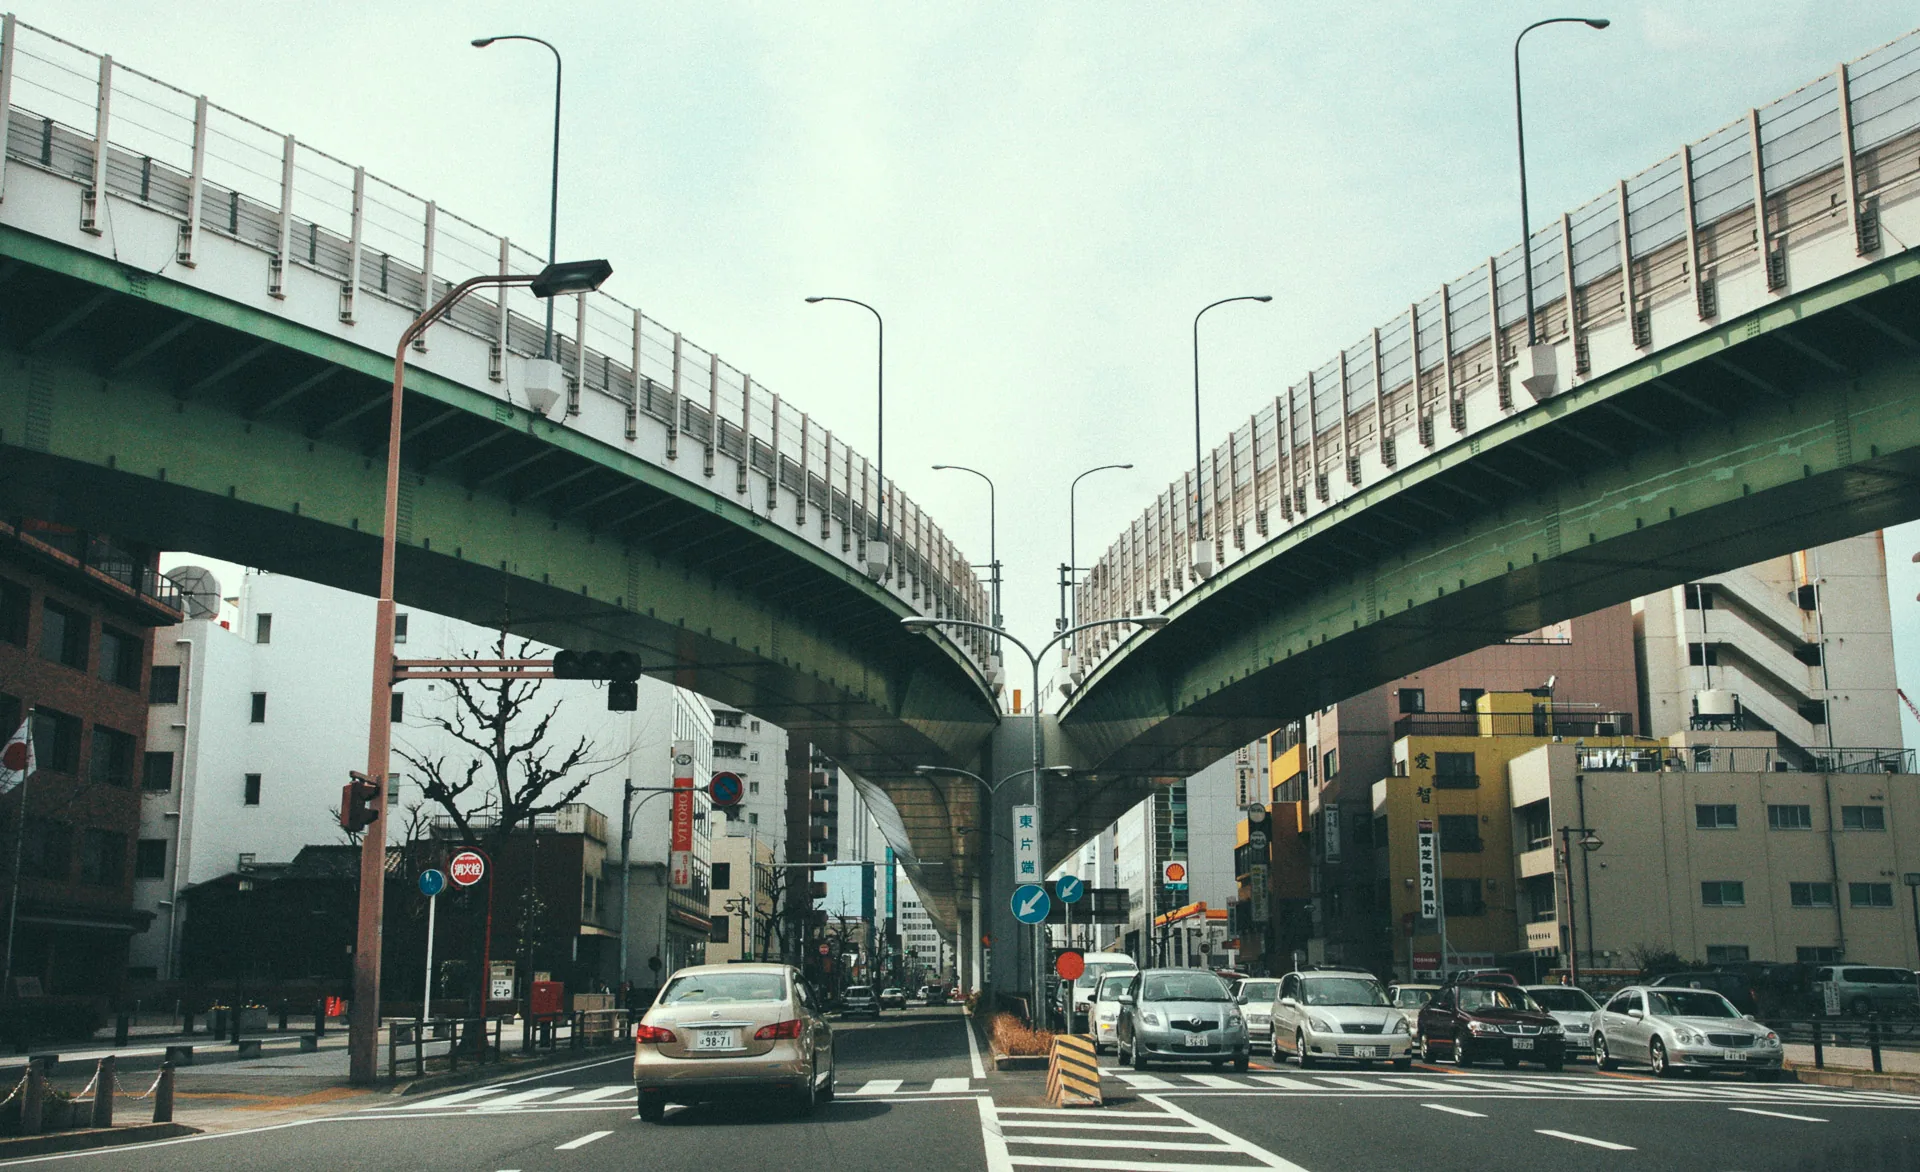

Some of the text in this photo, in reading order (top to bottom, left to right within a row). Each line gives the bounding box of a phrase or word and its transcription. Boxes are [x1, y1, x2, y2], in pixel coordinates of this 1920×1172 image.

[1019, 814, 1035, 875] 東片端
[454, 863, 481, 876] 消火栓
[1420, 836, 1435, 915] 東芝電力量計
[504, 989, 511, 997] P
[705, 1036, 731, 1047] 98-71
